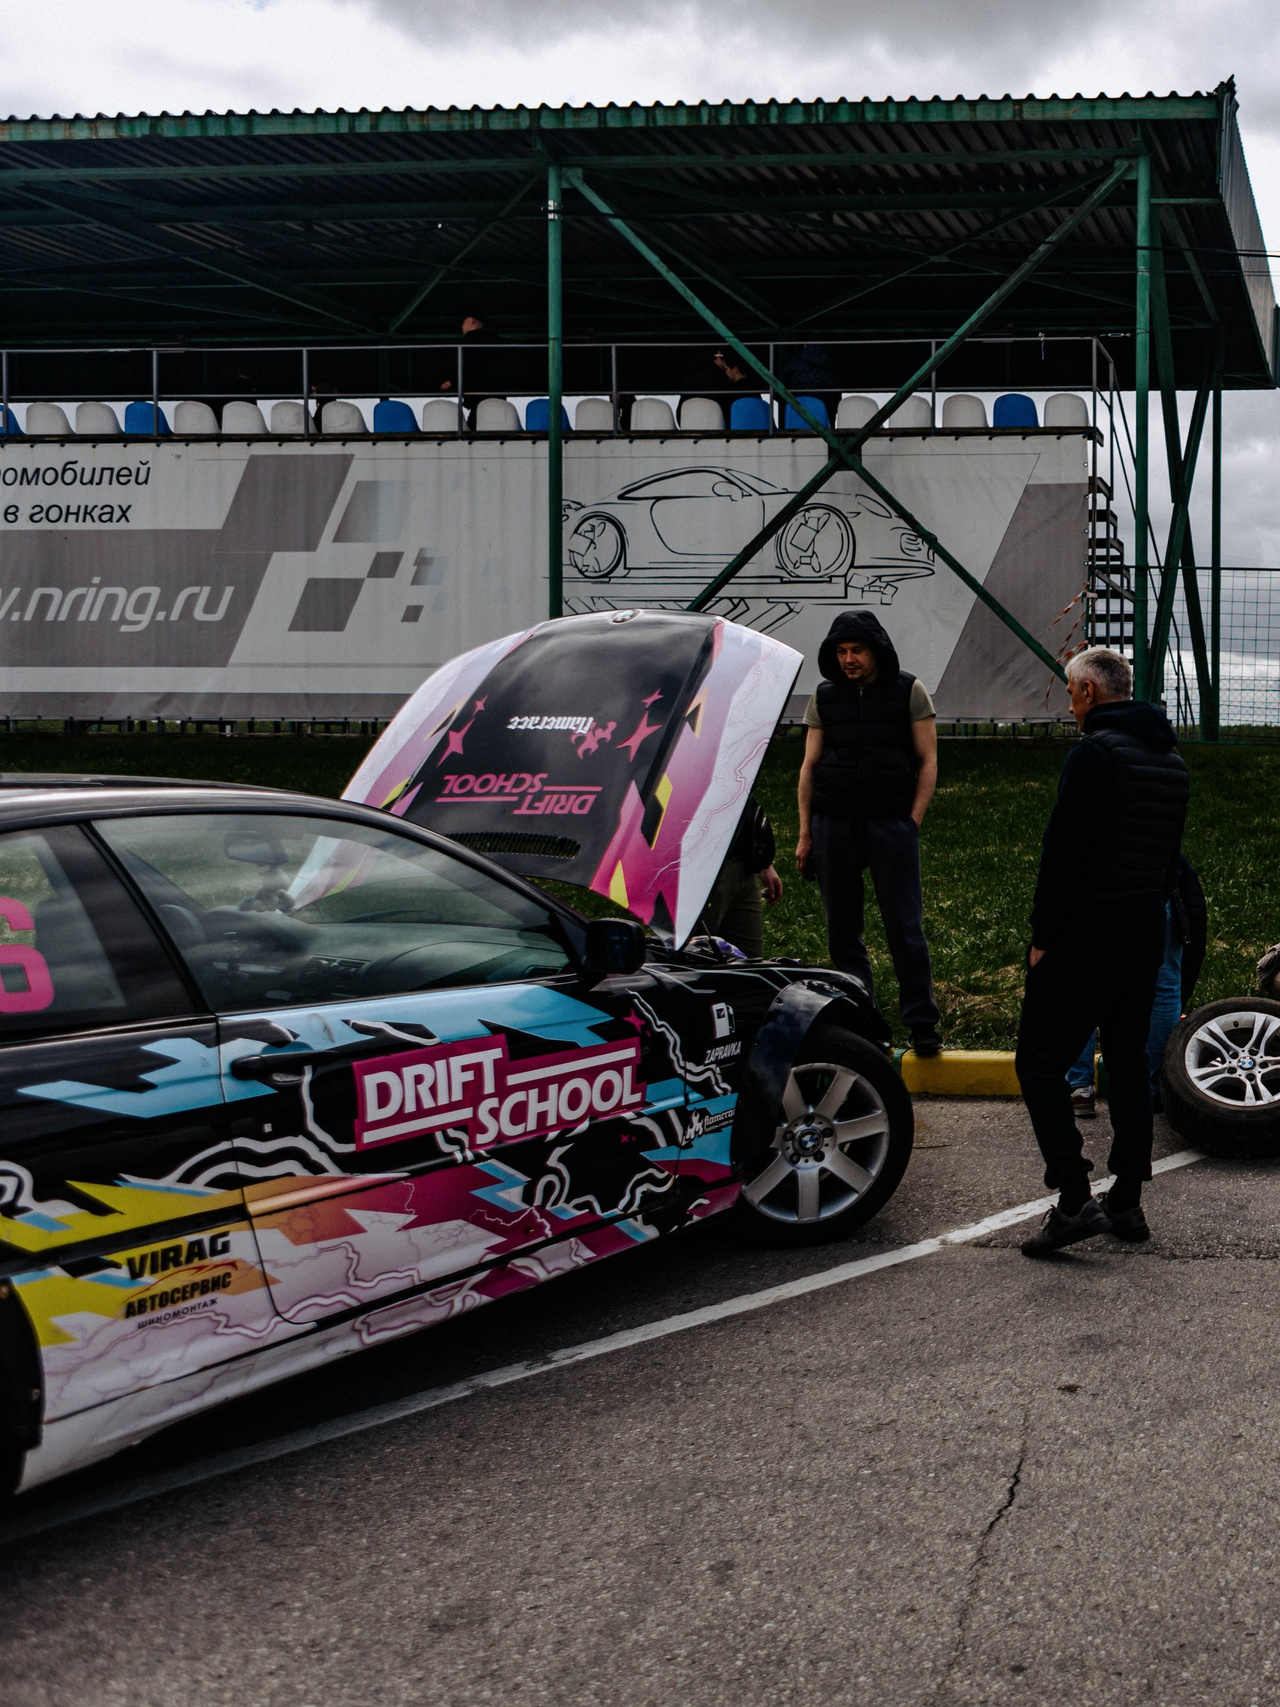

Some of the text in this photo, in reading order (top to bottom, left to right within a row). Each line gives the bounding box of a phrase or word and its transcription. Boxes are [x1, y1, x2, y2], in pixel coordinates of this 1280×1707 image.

[0, 460, 151, 486] омобилей
[3, 504, 133, 524] в гонках
[506, 716, 594, 734] flamerace
[444, 773, 549, 794] SCHOOL
[513, 794, 597, 814] DRIFT
[704, 1040, 742, 1064] ZAPRAVKA
[364, 1048, 504, 1123] DRIFT
[476, 1065, 642, 1144] SCHOOL
[126, 1231, 231, 1280] VIRAG
[125, 1272, 232, 1319] АВТОСЕРВИС
[137, 1298, 218, 1329] ШИНОМОНТАЖ
